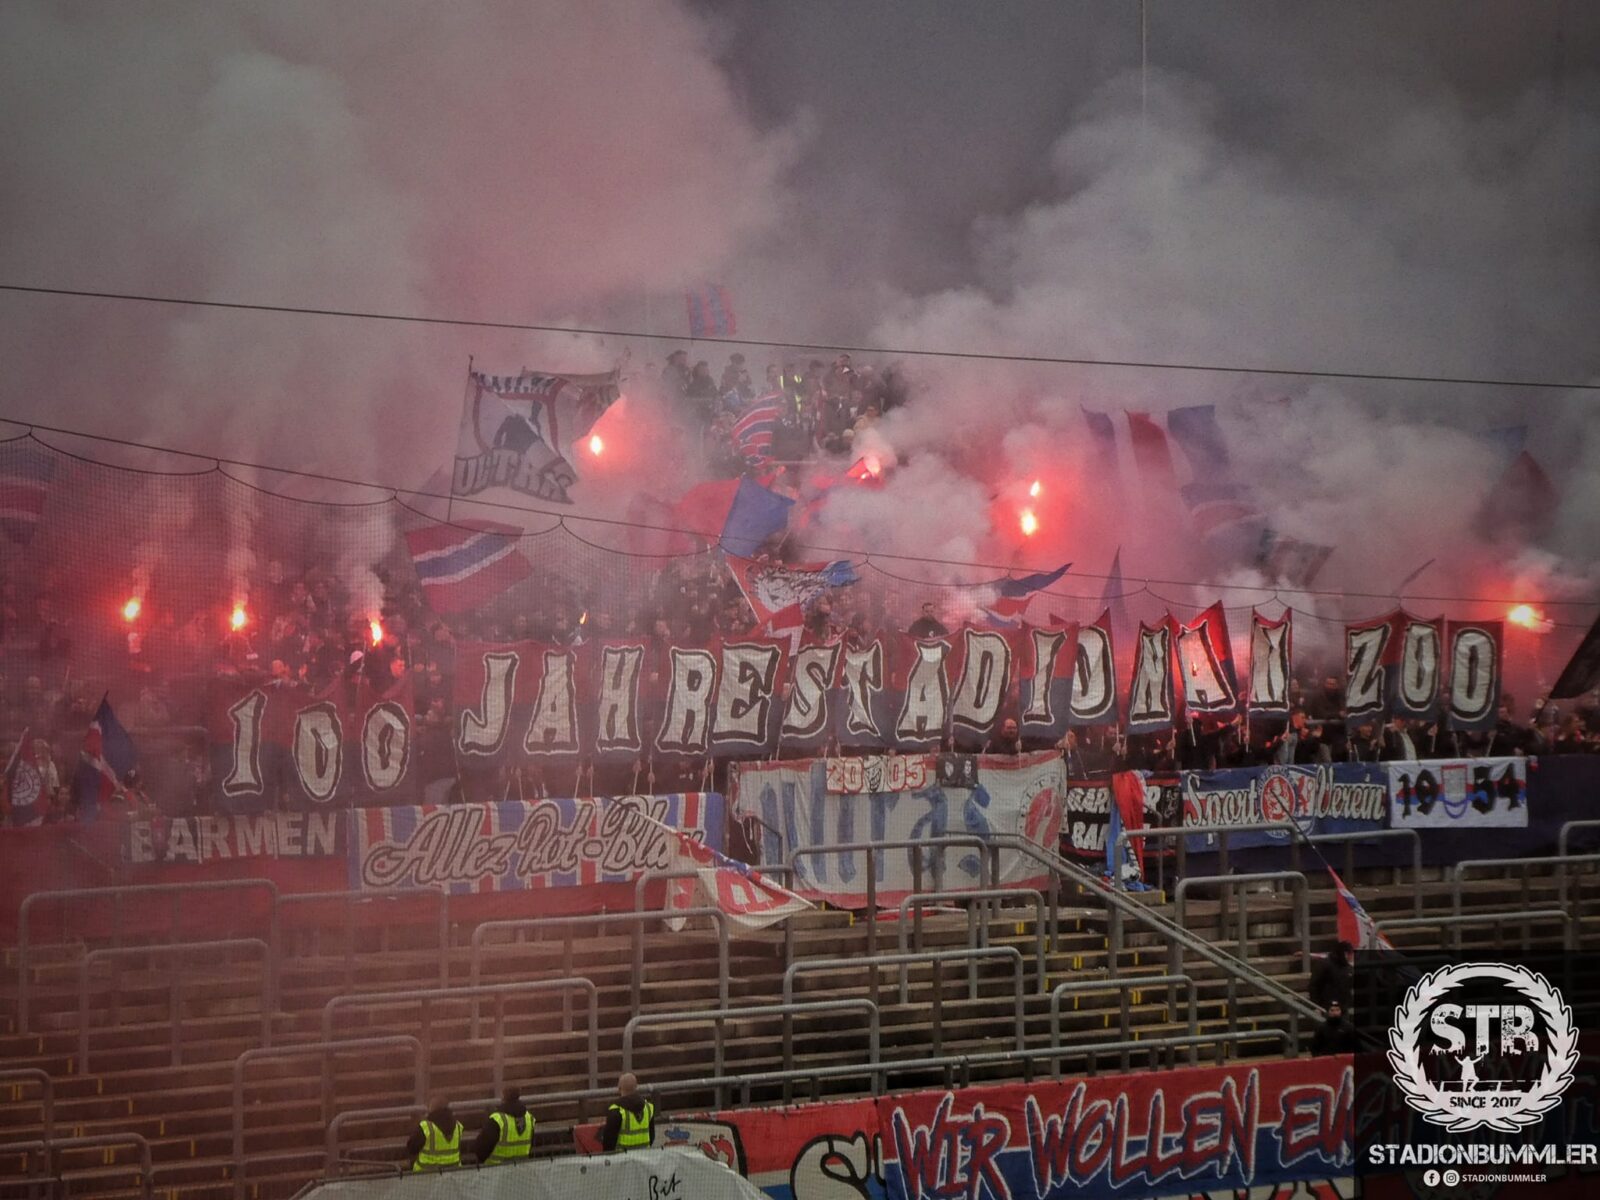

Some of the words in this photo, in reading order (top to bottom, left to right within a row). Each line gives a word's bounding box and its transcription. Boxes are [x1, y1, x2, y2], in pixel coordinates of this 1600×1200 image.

[222, 688, 411, 801] 100
[1344, 622, 1496, 722] ZOO
[130, 811, 337, 864] BARMEN
[1183, 771, 1259, 846] Sport
[1314, 763, 1386, 823] Verein
[362, 807, 517, 887] Allez
[892, 1090, 1013, 1200] WIR
[1023, 1068, 1259, 1200] WOLLEN
